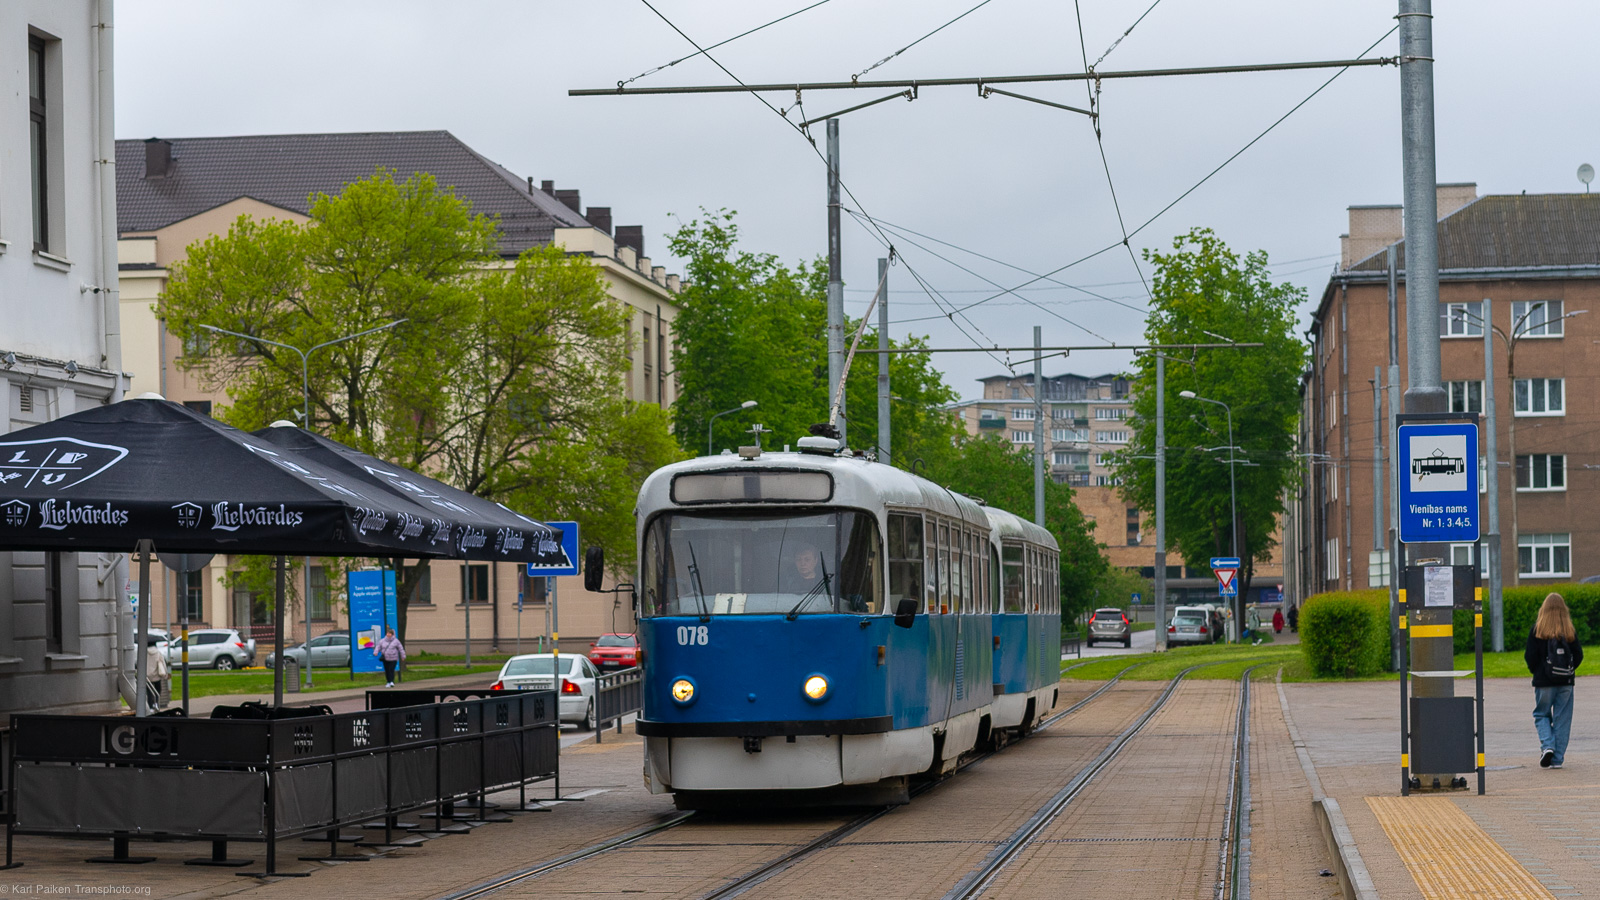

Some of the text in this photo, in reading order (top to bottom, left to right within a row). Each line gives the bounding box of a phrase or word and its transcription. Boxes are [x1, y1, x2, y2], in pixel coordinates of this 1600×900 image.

[39, 498, 129, 530] Lielvārdes
[211, 501, 303, 532] Lielvārdes
[1409, 504, 1468, 514] Vienības nams
[1422, 518, 1435, 528] Nr.
[727, 596, 734, 614] 1
[677, 625, 709, 646] 078
[100, 725, 179, 756] IGGI
